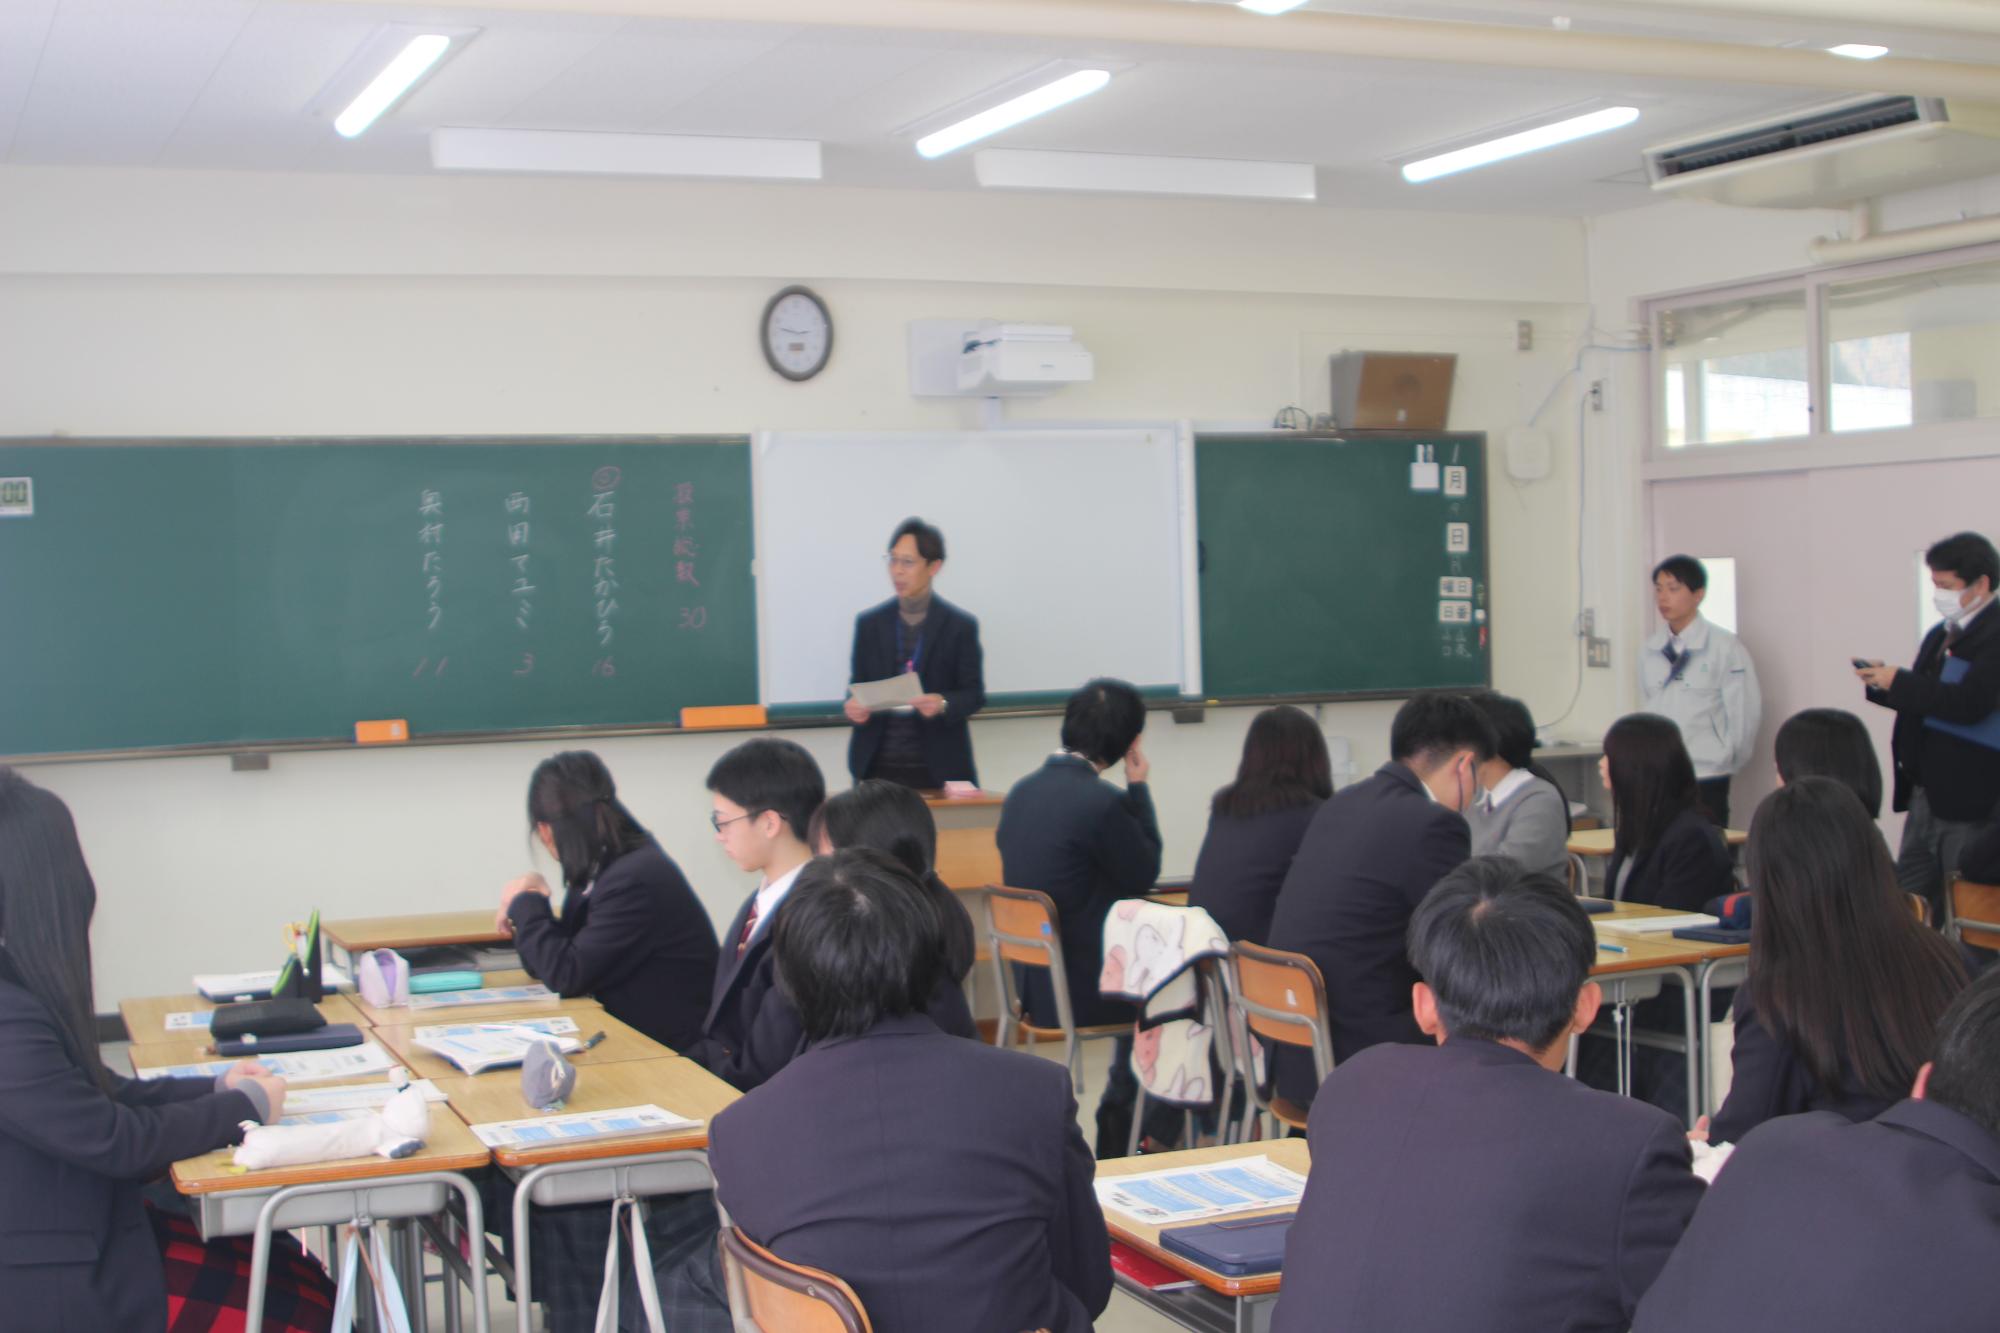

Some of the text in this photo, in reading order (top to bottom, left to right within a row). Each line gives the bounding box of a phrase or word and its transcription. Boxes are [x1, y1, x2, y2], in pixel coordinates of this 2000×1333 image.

[1448, 470, 1463, 489] 月
[1451, 528, 1465, 545] 日
[678, 606, 707, 629] 30
[512, 652, 535, 674] 3
